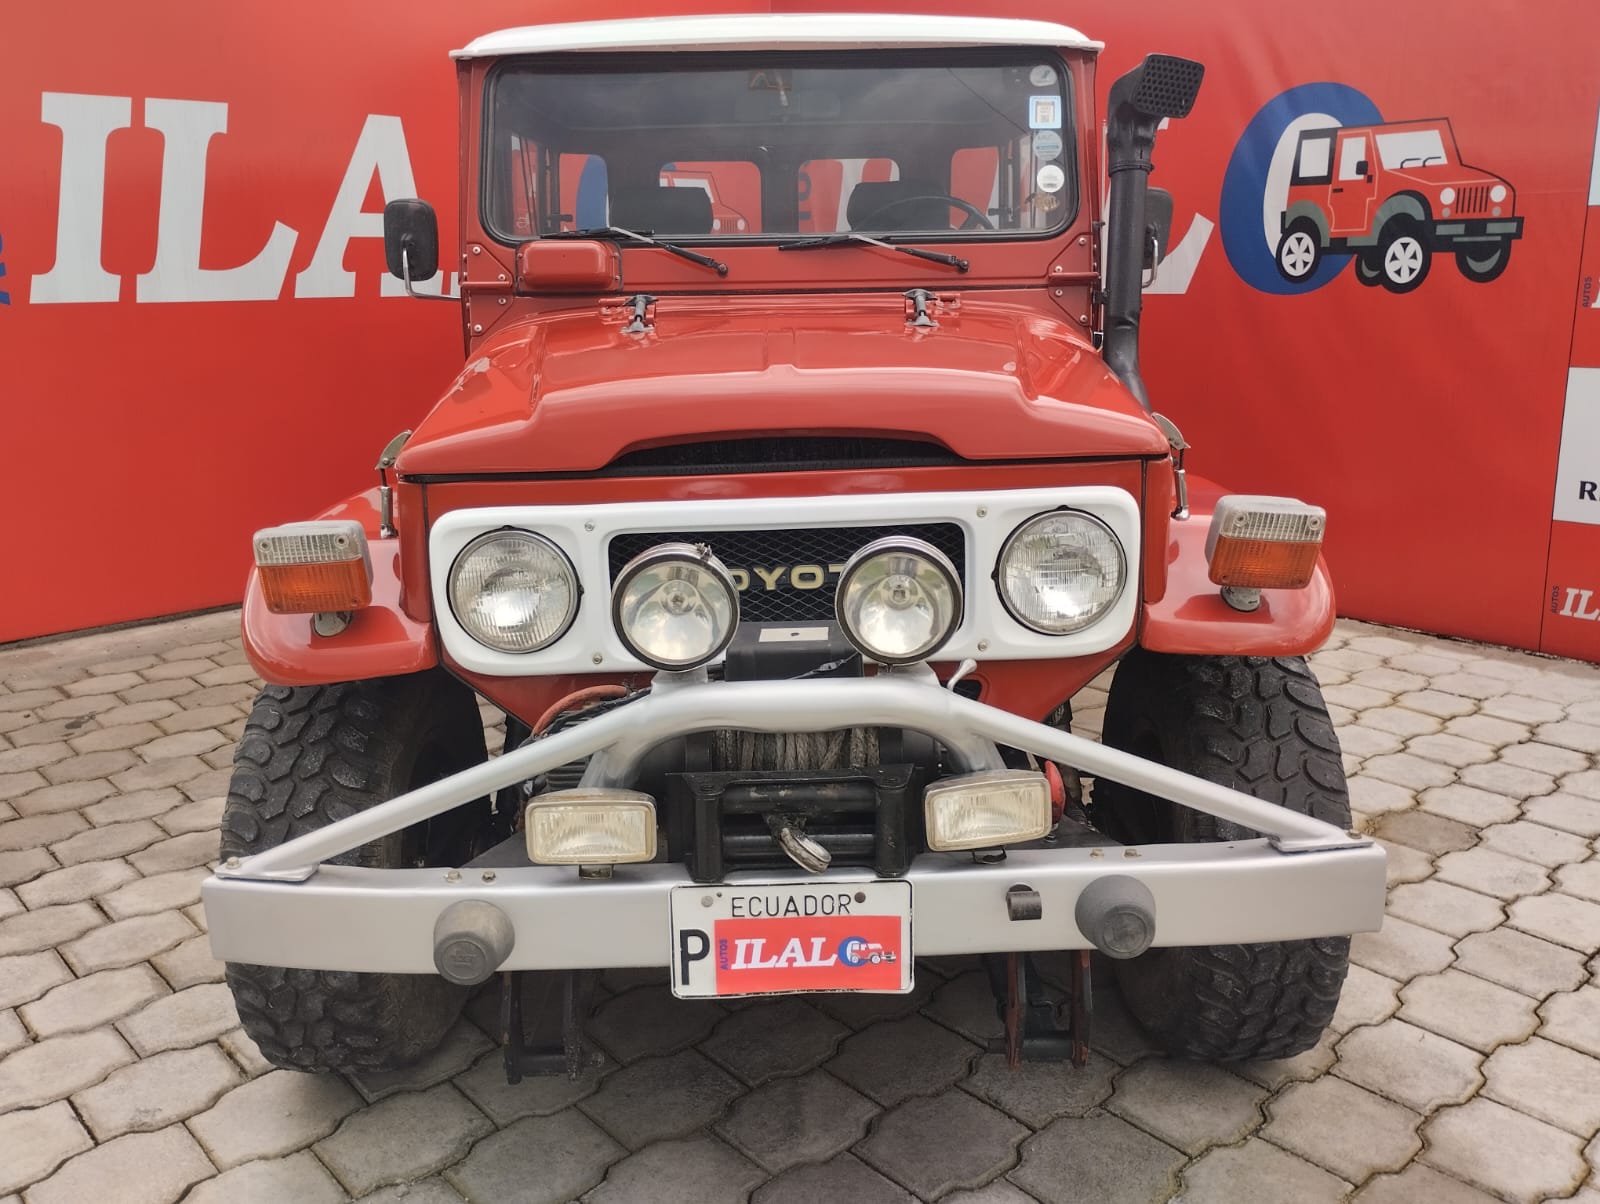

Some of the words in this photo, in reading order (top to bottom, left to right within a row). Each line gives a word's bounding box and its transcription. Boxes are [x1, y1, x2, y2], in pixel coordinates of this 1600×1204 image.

[1551, 585, 1560, 614] AUTOS
[1559, 587, 1600, 622] IL
[730, 893, 852, 918] ECUADOR
[679, 928, 711, 986] P
[719, 938, 729, 971] AUTOS
